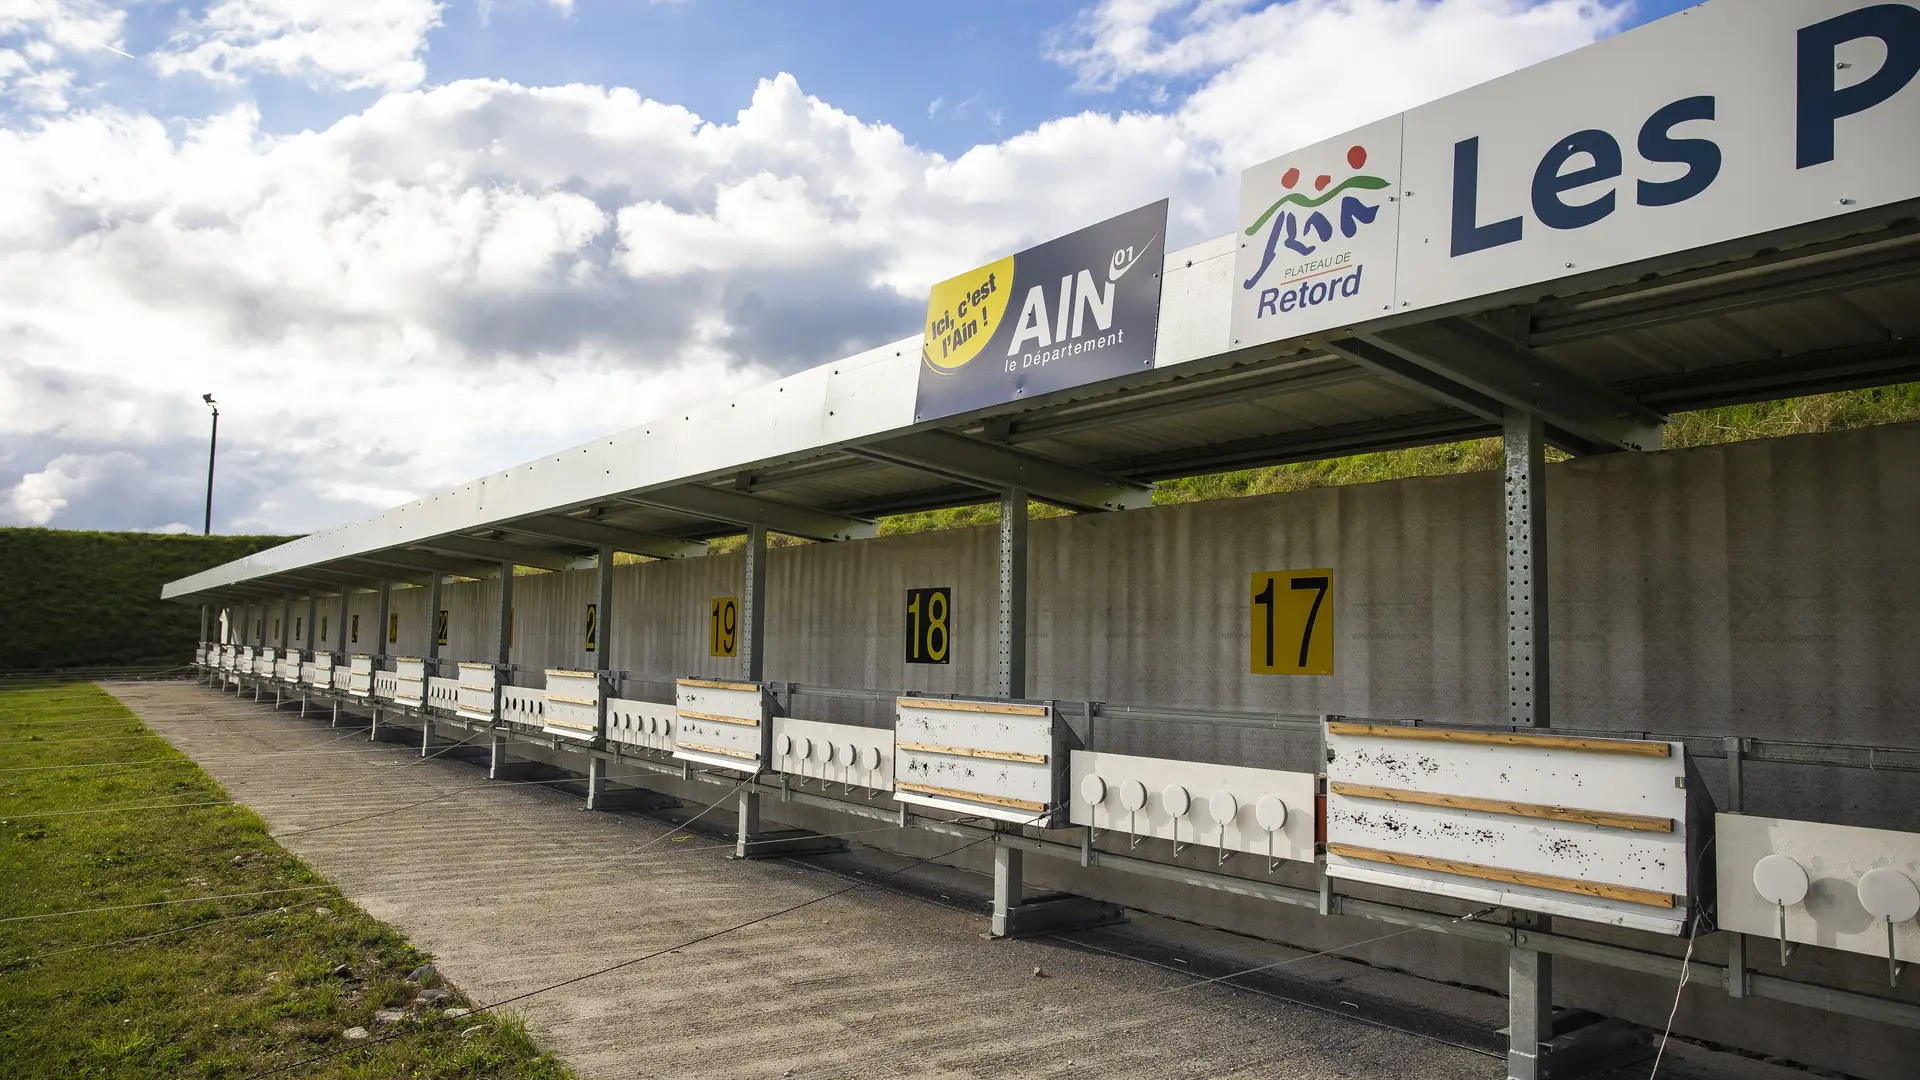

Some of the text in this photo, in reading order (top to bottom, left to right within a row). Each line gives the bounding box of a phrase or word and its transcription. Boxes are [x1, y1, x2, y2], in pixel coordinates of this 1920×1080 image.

[1450, 95, 1722, 257] Les
[1114, 245, 1134, 265] 01
[1284, 252, 1351, 278] PLATEAU DE
[931, 272, 996, 340] Ici, c'est
[1007, 268, 1115, 357] AIN
[1257, 264, 1363, 319] Retord
[942, 306, 988, 358] l'Ain !
[1004, 329, 1123, 373] le Département
[587, 607, 595, 648] 2
[712, 601, 736, 653] 19
[908, 592, 947, 660] 18
[1254, 577, 1329, 667] 17
